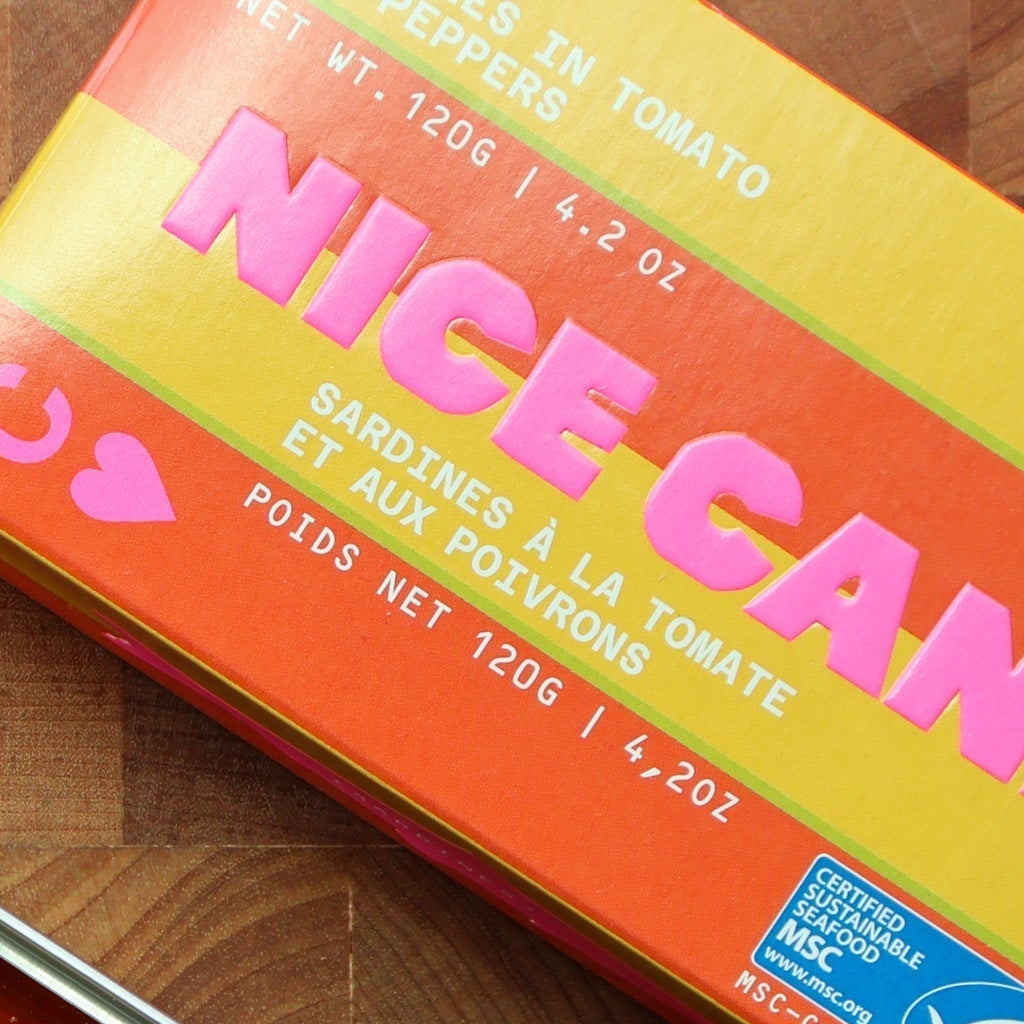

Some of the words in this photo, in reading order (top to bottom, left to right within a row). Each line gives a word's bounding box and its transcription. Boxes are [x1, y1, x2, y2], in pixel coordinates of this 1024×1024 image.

[377, 0, 569, 123] PEPPERS
[448, 0, 521, 36] ES
[534, 29, 596, 85] IN
[610, 76, 771, 200] TOMATO
[326, 41, 385, 101] WT.
[405, 92, 497, 168] 120G
[555, 193, 627, 253] 4.2
[638, 247, 687, 292] OZ
[161, 105, 659, 502] NICE
[644, 431, 1024, 796] CAN
[281, 418, 344, 470] ET
[349, 467, 438, 536] AUX
[443, 525, 651, 677] POIVRONS
[310, 382, 513, 530] SARDINES
[523, 517, 558, 562] À
[569, 553, 626, 607] LA
[644, 596, 798, 718] TOMATE
[242, 482, 361, 573] POIDS
[375, 570, 452, 630] NET
[471, 630, 564, 708] 120G
[776, 918, 843, 973] MSC
[792, 900, 881, 964] SEAFOOD
[804, 883, 926, 970] SUSTAINABLE
[816, 867, 906, 933] CERTIFIED
